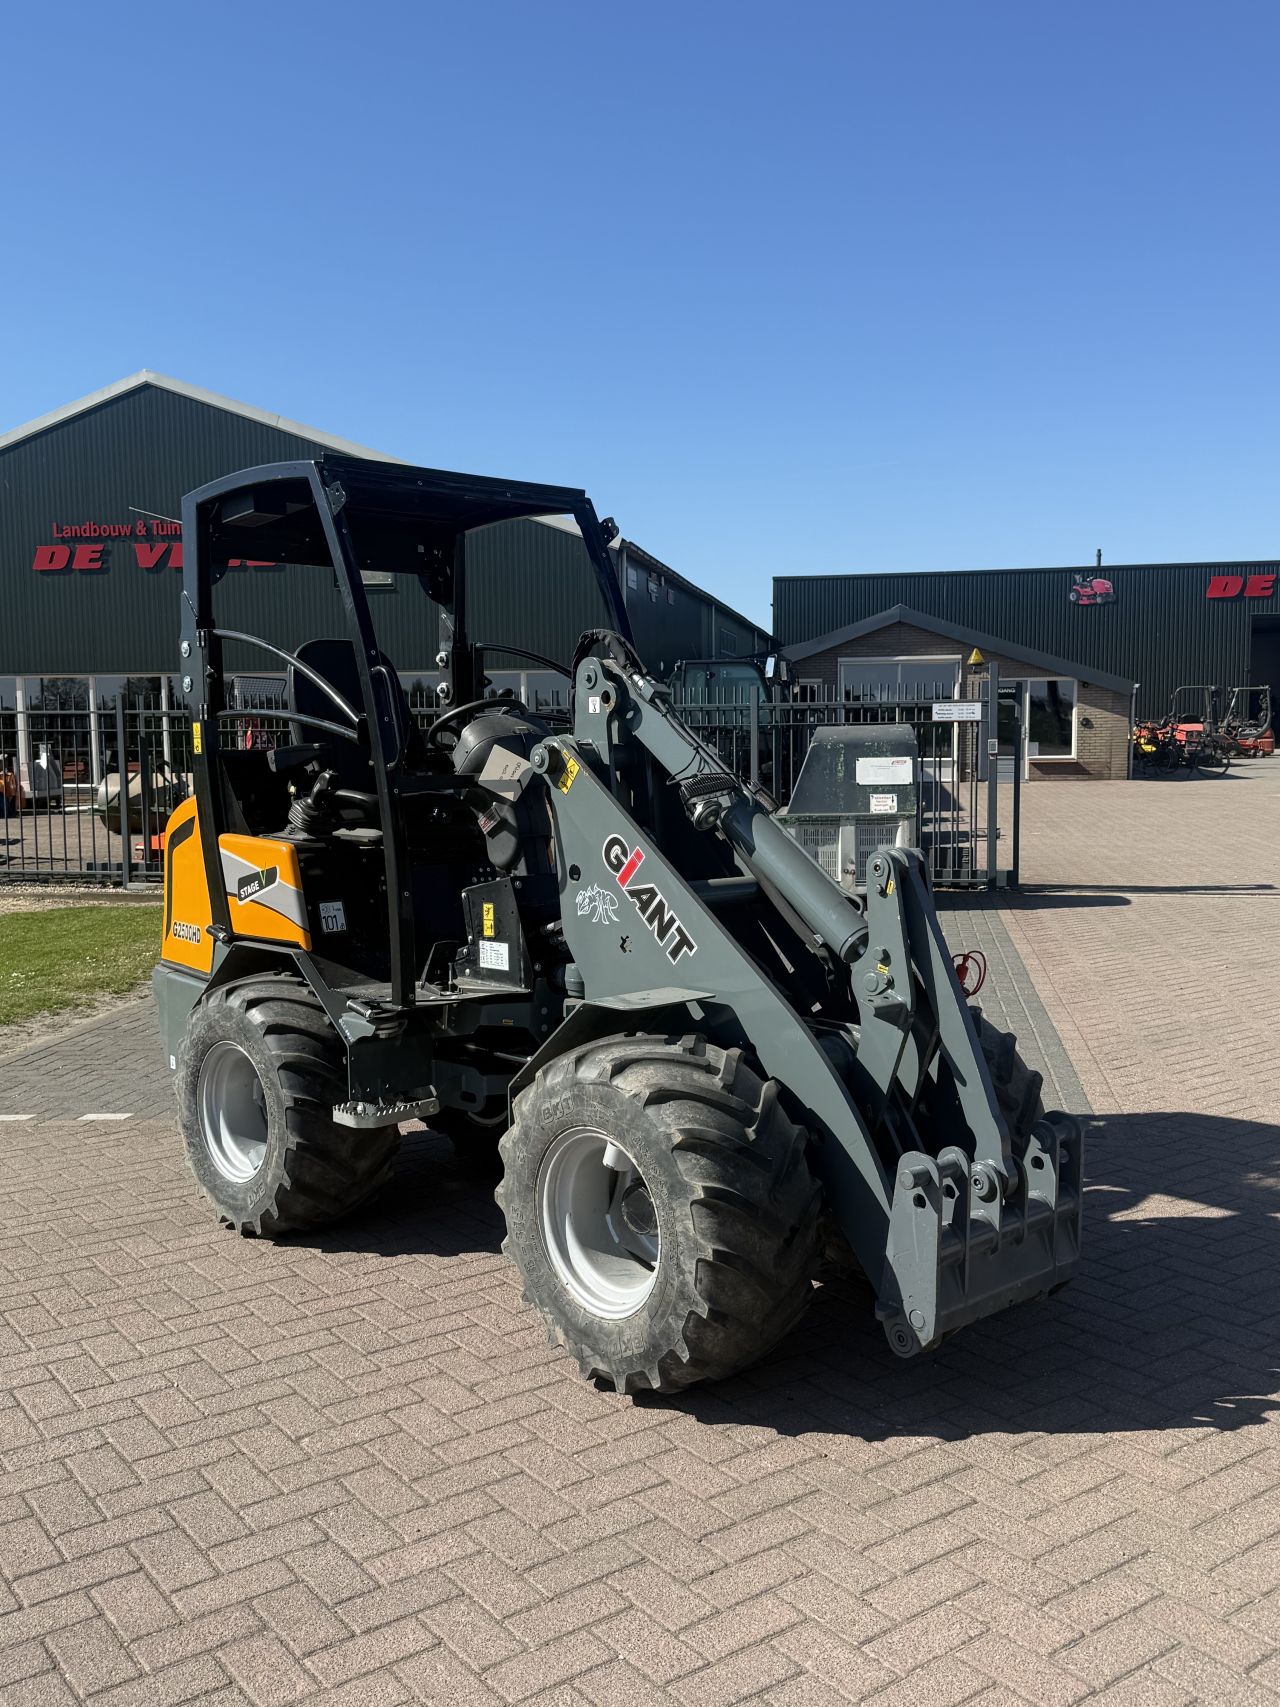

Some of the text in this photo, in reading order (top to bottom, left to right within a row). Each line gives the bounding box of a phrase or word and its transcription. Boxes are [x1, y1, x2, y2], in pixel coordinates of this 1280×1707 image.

[52, 521, 132, 538] Landbouw
[136, 520, 147, 536] &
[32, 544, 105, 570] DE
[1206, 574, 1277, 599] DE
[240, 881, 260, 898] STAGE
[602, 833, 698, 965] GIANT
[173, 921, 201, 944] G2500HD
[322, 914, 339, 931] 101
